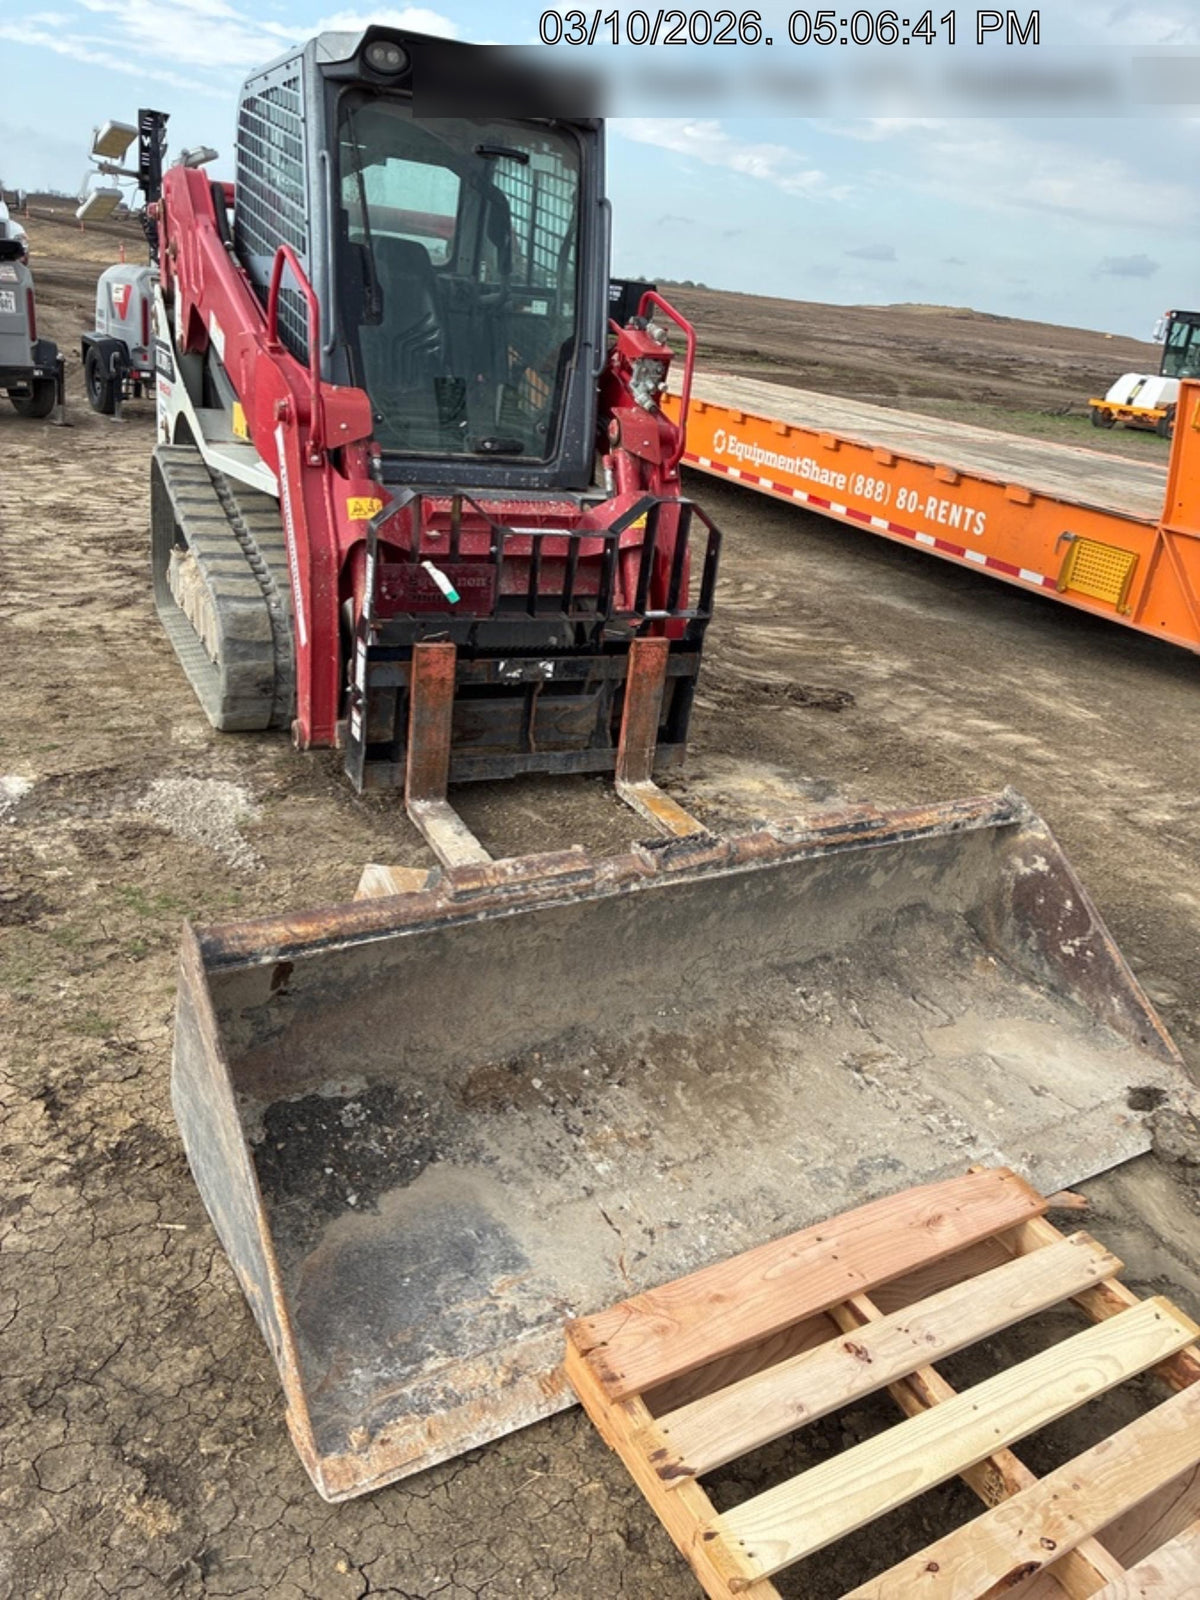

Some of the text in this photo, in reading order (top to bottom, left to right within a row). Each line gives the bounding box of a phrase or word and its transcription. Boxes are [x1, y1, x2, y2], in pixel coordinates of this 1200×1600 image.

[728, 436, 987, 536] EquipmentShare (888) 80-RENTS
